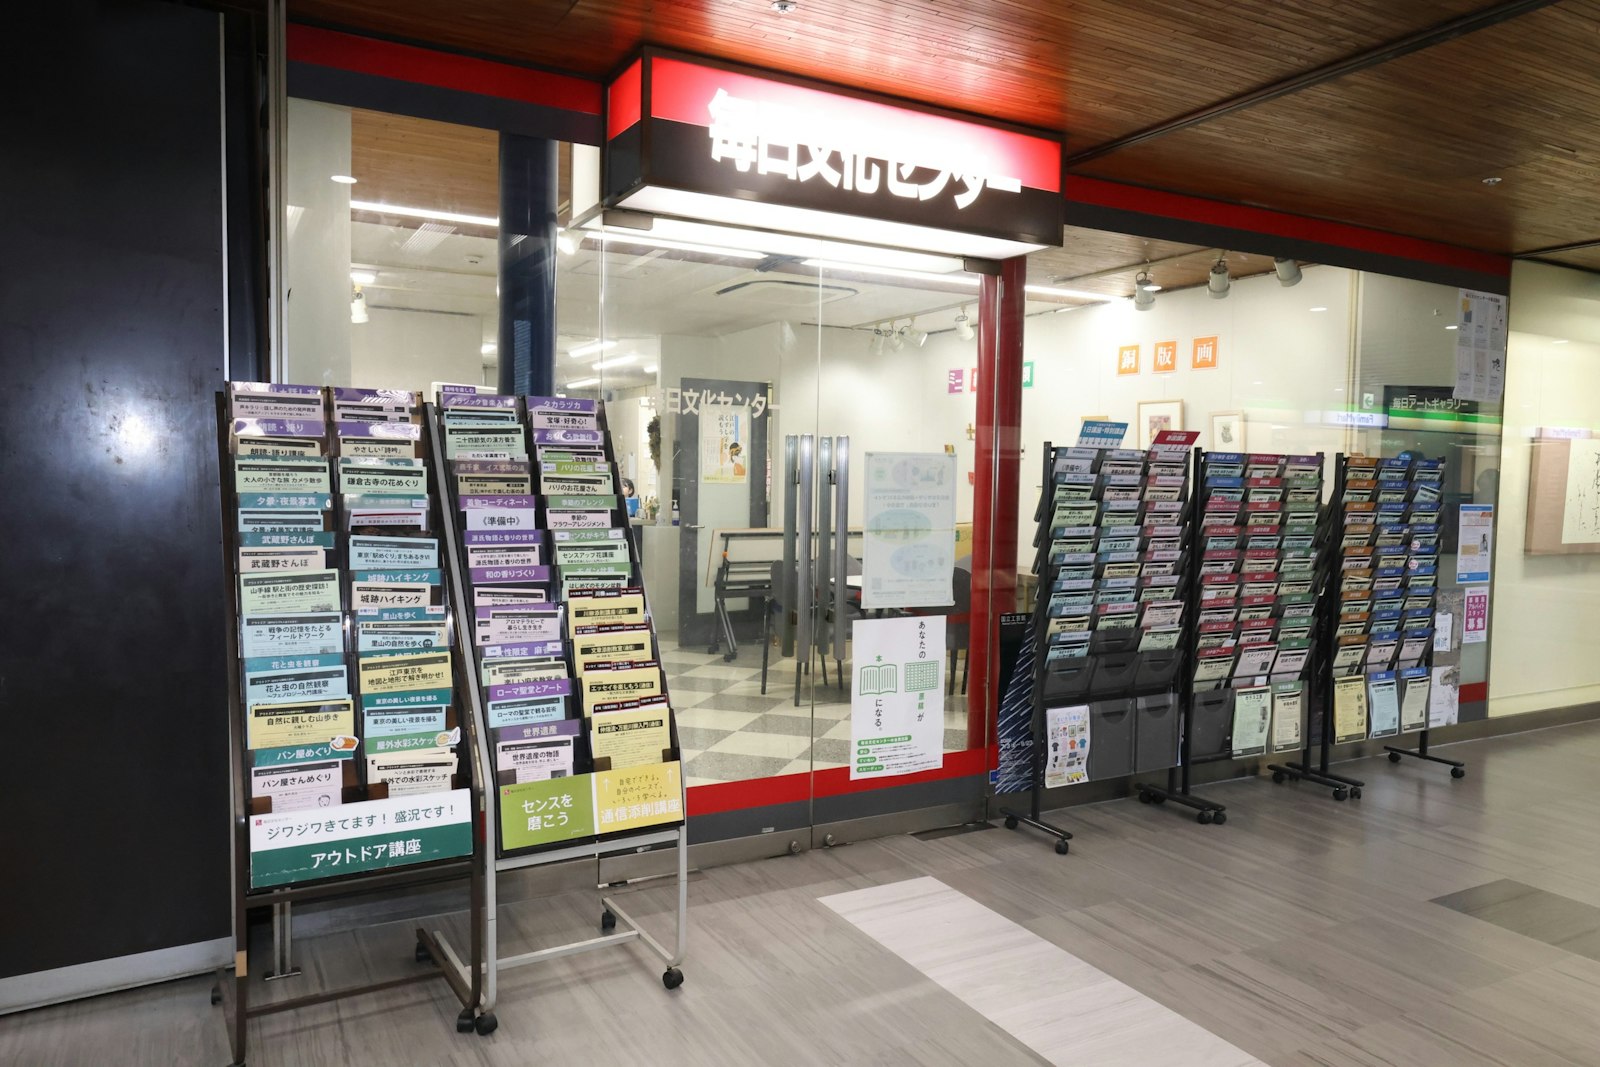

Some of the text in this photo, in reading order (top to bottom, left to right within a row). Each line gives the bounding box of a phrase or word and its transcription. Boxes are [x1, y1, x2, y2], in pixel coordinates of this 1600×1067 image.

[707, 87, 1022, 210] 毎日文化センター
[1121, 342, 1213, 369] 銅版画
[543, 400, 581, 410] タカラヅカ
[1392, 396, 1469, 410] 毎日アートギャラリー
[259, 423, 304, 433] 朗読・語り
[244, 476, 323, 485] 大人の小さな旅 カメラ散歩
[346, 477, 420, 488] 鎌倉古寺の花めぐり
[256, 496, 317, 507] 夕景・夜景写真
[561, 498, 605, 507] 季節のアレンジ
[570, 514, 588, 522] 季節の
[552, 520, 606, 528] フラワーアレンジメント
[261, 534, 314, 545] 武蔵野さんぽ
[471, 534, 535, 543] 源氏物語と香りの世界
[562, 551, 615, 559] センスアップ花講座
[250, 558, 309, 569] 武蔵野さんぽ
[475, 557, 532, 567] 源氏物語と香りの世界
[367, 572, 430, 583] 城跡ハイキング
[485, 569, 536, 579] 和の香りづくり
[250, 585, 272, 595] 山手線
[360, 594, 422, 604] 城跡ハイキング
[382, 611, 417, 620] 里山を歩く
[268, 624, 332, 634] 戦争の記憶をたどる
[507, 623, 543, 631] 暮らし生き生き
[1467, 617, 1485, 630] 募集
[268, 632, 325, 641] フィールドワーク
[918, 621, 926, 659] あなたの
[371, 639, 423, 648] 里山の自然を歩く
[875, 654, 883, 663] 本
[271, 659, 320, 670] 花と虫を観察
[389, 667, 424, 677] 江戸東京を
[265, 679, 330, 693] 花と虫の自然観察
[496, 682, 563, 697] ローマ聖堂とアート
[375, 693, 438, 705] 東京の美しい夜景を撮る
[497, 706, 558, 718] ローマの聖堂で観る芸術
[266, 713, 339, 726] 自然に親しむ山歩き
[372, 714, 438, 725] 東京の美しい夜景を撮る
[522, 725, 558, 738] 世界遺産
[276, 748, 332, 761] パン屋めぐり
[512, 750, 560, 762] 世界遺産の物語
[262, 773, 332, 788] パン屋さんめぐり
[521, 793, 574, 815] センスを
[600, 799, 682, 825] 通信添削講座
[527, 811, 570, 832] 磨こう
[310, 837, 422, 869] アウトドア講座
